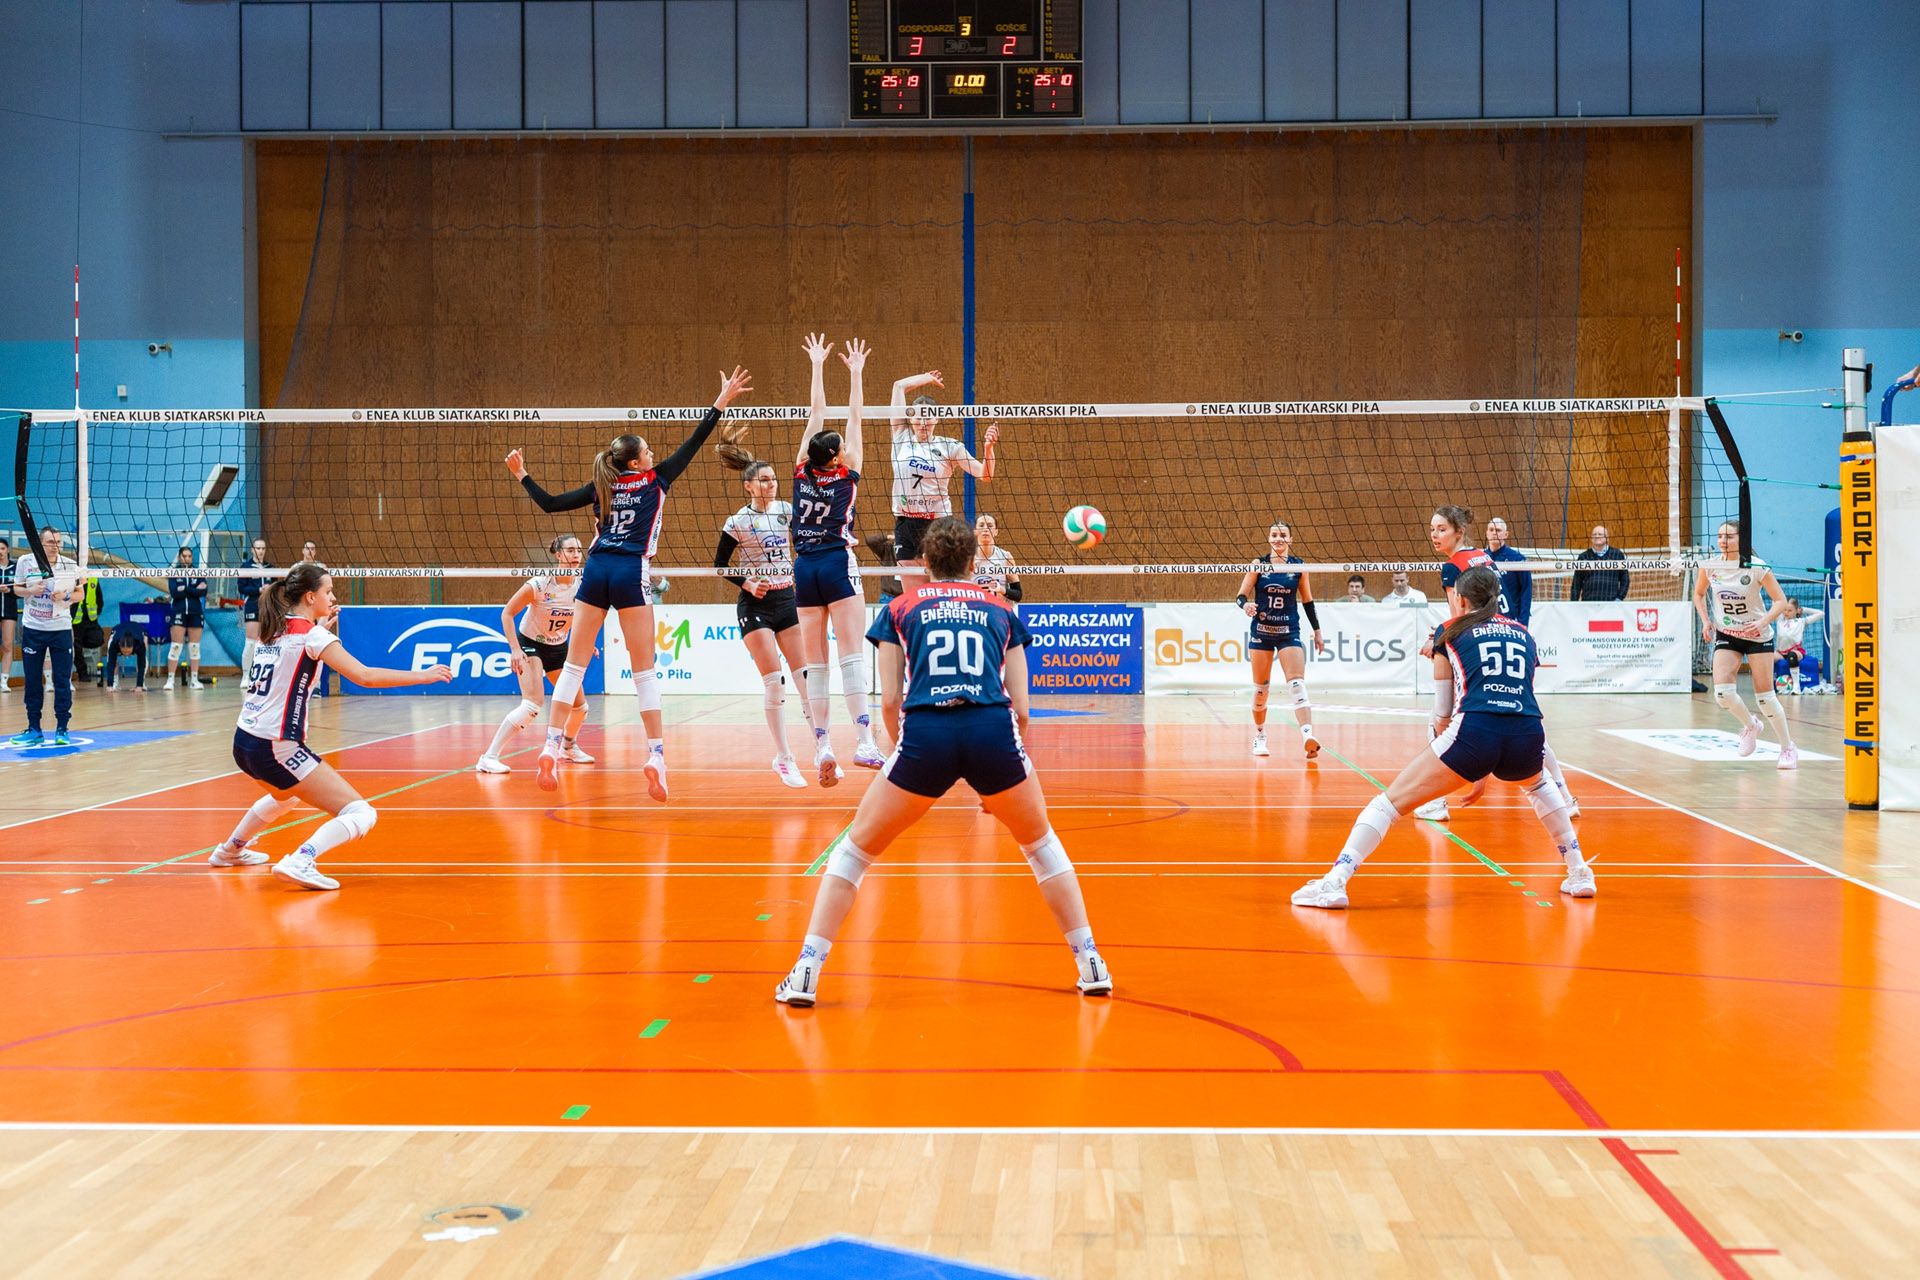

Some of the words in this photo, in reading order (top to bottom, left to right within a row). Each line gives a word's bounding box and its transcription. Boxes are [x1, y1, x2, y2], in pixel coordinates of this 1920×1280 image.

[898, 24, 955, 33] GOSPODARZE
[960, 24, 971, 36] 3
[995, 23, 1028, 32] GOŚCIE
[909, 37, 923, 55] 3
[1002, 36, 1017, 55] 2
[954, 75, 986, 87] 0.00
[863, 90, 869, 98] 2
[863, 103, 869, 111] 3
[920, 407, 956, 417] ENEA
[957, 406, 990, 417] KLUB
[993, 406, 1065, 417] SIATKARSKI
[1069, 405, 1097, 416] PIŁA
[1200, 404, 1235, 415] ENEA
[1238, 403, 1271, 414] KLUB
[1274, 403, 1348, 414] SIATKARSKI
[1352, 402, 1380, 413] PIŁA
[1484, 401, 1519, 411] ENEA
[1522, 400, 1556, 410] KLUB
[1559, 400, 1633, 410] SIATKARSKI
[1639, 399, 1666, 409] PIŁA
[92, 411, 126, 421] ENEA
[129, 411, 161, 421] KLUB
[164, 411, 234, 421] SIATKARSKI
[240, 411, 266, 421] PIŁA
[366, 410, 400, 420] ENEA
[403, 410, 435, 420] KLUB
[438, 410, 509, 420] SIATKARSKI
[513, 410, 541, 420] PIŁA
[642, 409, 676, 419] ENEA
[720, 408, 786, 419] IATKARSKI
[790, 408, 810, 418] PIŁ
[908, 459, 936, 473] Enea
[911, 473, 924, 489] 7
[610, 496, 642, 506] ERGETYK
[799, 498, 831, 525] 77
[609, 510, 636, 534] 12
[1851, 471, 1873, 567] SPORT
[767, 549, 783, 564] 14
[727, 567, 753, 576] ENEA
[754, 567, 779, 576] KLUB
[974, 566, 986, 575] UB
[988, 566, 1041, 574] SIATKARSKI
[1044, 566, 1065, 574] PIŁA
[1143, 566, 1169, 574] ENEA
[1171, 565, 1195, 573] KLUB
[1197, 565, 1251, 573] SIATKARSKI
[1253, 564, 1275, 572] PIŁA
[1381, 563, 1406, 571] KLUB
[1408, 562, 1441, 571] SIATKA
[1566, 562, 1591, 570] ENEA
[1594, 562, 1619, 570] KLUB
[1684, 561, 1699, 569] IŁA
[112, 569, 140, 577] ENEA
[142, 569, 163, 577] KLUB
[165, 569, 218, 577] SIATKARSKI
[220, 569, 240, 577] PIŁA
[330, 569, 341, 577] EA
[343, 569, 367, 577] KLUB
[369, 569, 421, 577] SIATKARSKI
[424, 569, 445, 577] PIŁA
[1267, 586, 1292, 594] Enea
[938, 601, 968, 610] ENEA
[1267, 596, 1284, 609] 18
[1722, 602, 1749, 615] 22
[920, 608, 989, 627] ENERGETYK
[1027, 613, 1134, 627] ZAPRASZAMY
[1266, 614, 1290, 622] eneris
[548, 619, 567, 632] 19
[1032, 633, 1055, 647] DO
[1058, 633, 1131, 647] NASZYCH
[1472, 626, 1527, 642] ENERGETYK
[926, 629, 985, 677] 20
[1155, 629, 1406, 665] astalistics
[411, 643, 512, 679] Ene
[1041, 650, 1120, 668] SALONÓW
[1478, 640, 1527, 680] 55
[668, 668, 692, 679] Piła
[1032, 674, 1131, 687] MEBLOWYCH
